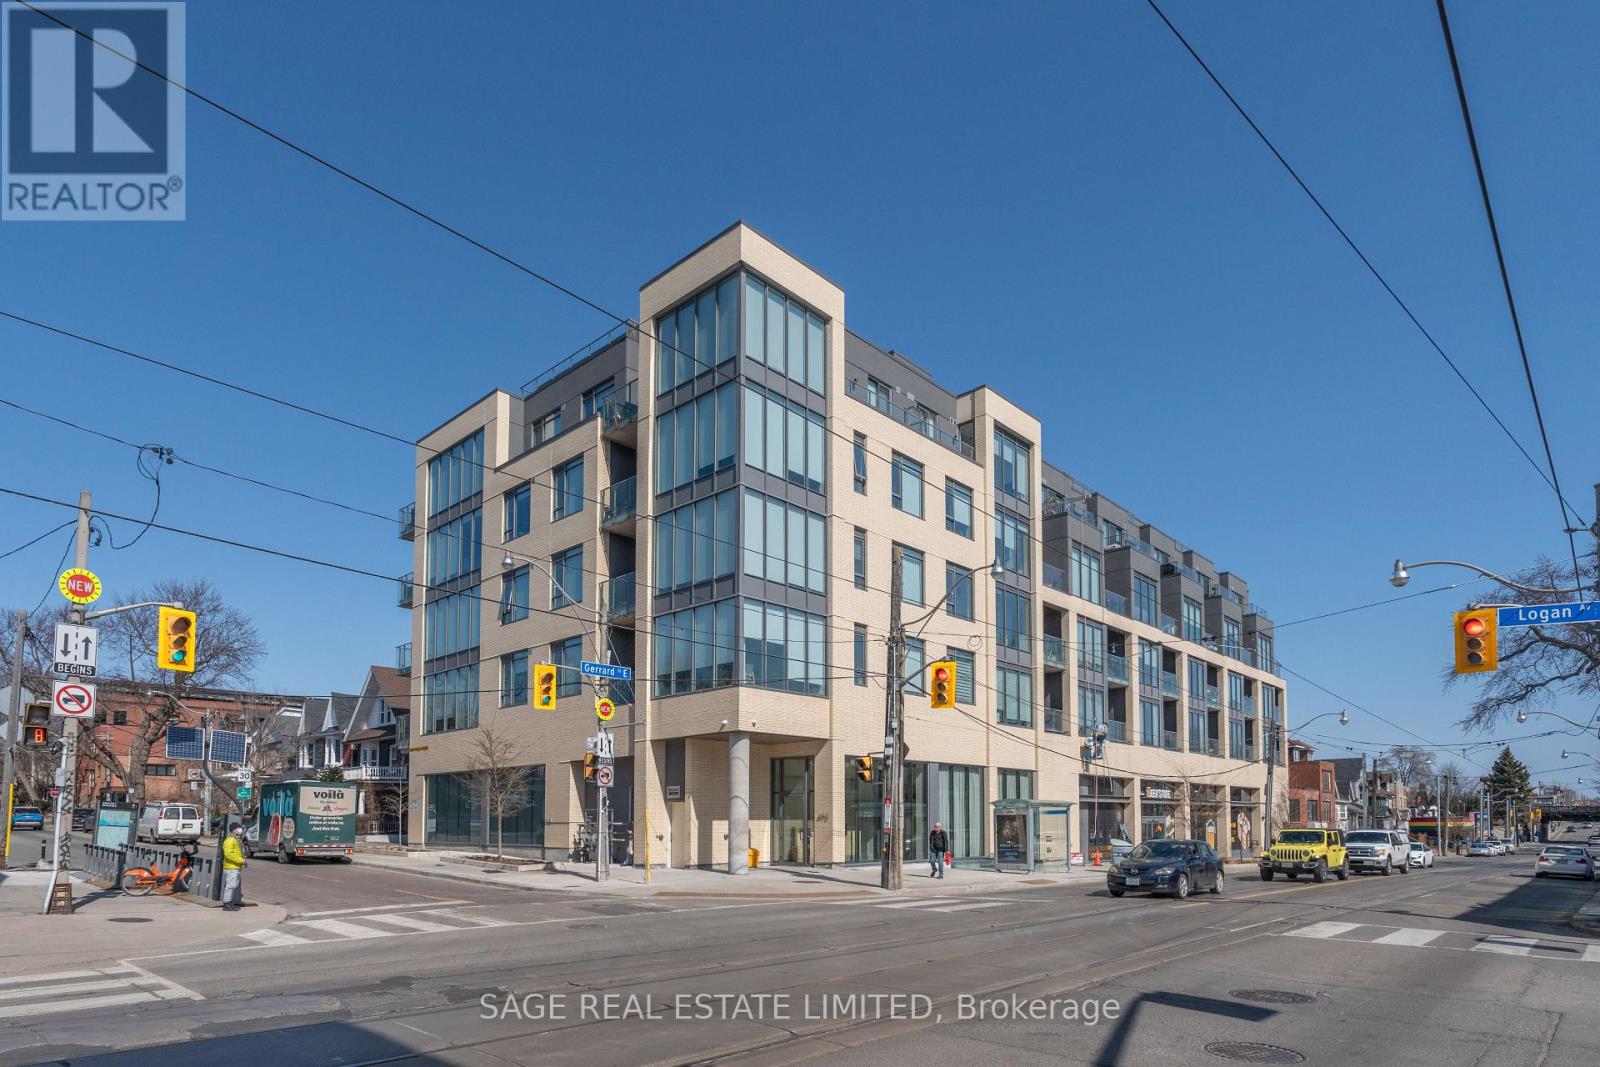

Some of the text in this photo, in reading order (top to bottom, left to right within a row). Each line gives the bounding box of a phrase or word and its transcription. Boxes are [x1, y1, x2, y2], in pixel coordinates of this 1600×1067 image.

[67, 579, 93, 593] NEW
[1519, 607, 1572, 623] Logan
[57, 663, 93, 675] BEGINS
[584, 663, 615, 676] Gerrard
[623, 669, 628, 678] E
[239, 772, 250, 780] 30
[313, 789, 345, 799] voilà
